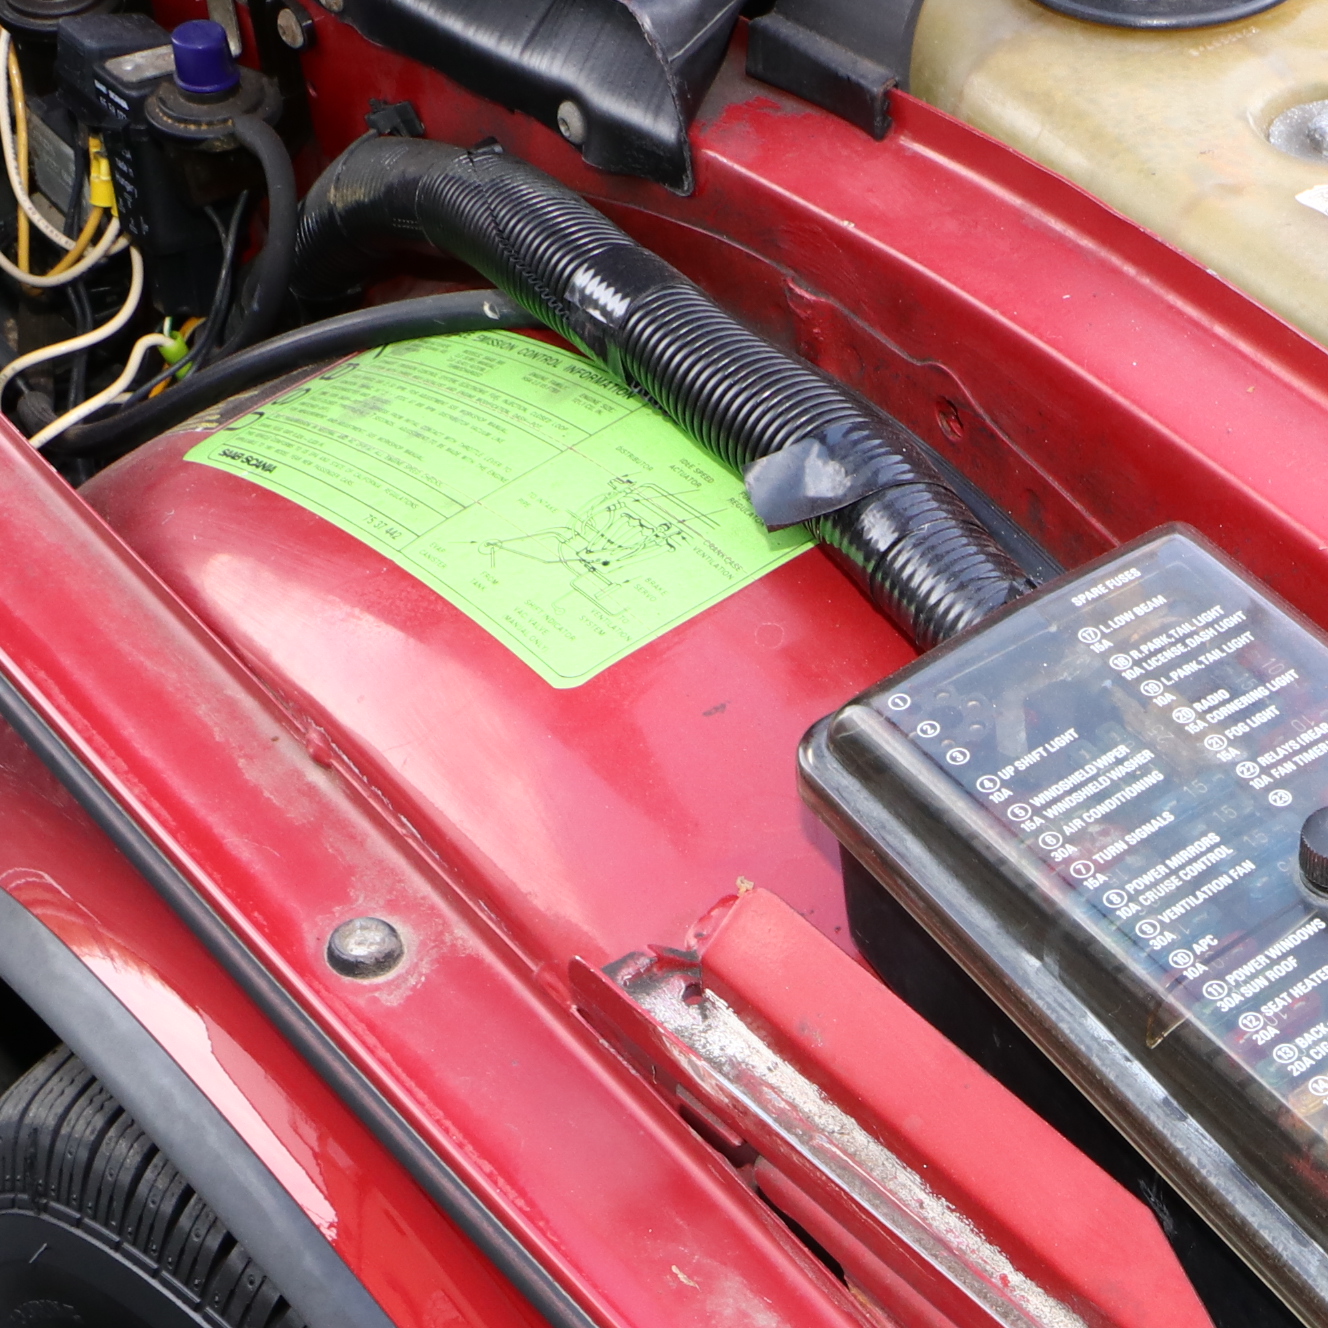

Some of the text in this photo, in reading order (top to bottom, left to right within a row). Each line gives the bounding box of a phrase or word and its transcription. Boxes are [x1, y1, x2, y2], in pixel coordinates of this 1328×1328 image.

[517, 346, 562, 367] CONTROL
[563, 365, 636, 399] INFORMATION
[1070, 567, 1141, 606] SPARE FUSES
[1099, 595, 1167, 633] L.LOW BEAM
[1129, 605, 1225, 660] R.PARK,TAIL LIGHT
[1089, 638, 1113, 653] 15A
[1122, 611, 1248, 680] 10A LICENSE,DASH LIGHT
[1160, 631, 1256, 686] L.PARK,TAIL LIGHT
[1152, 691, 1176, 706] 10A
[1184, 719, 1208, 734] 15A
[1205, 686, 1270, 723] CORNERING
[1265, 669, 1299, 690] LIGHT
[1193, 689, 1231, 711] RADIO
[1224, 706, 1281, 738] FOG LIGHT
[997, 728, 1081, 779] UP SHIFT LIGHT
[1216, 747, 1240, 761] 15A
[1257, 740, 1300, 766] RELAYS
[1020, 749, 1156, 832] 15A WINDSHIELD WASHER
[1029, 745, 1130, 806] WINDSHIELD WIPER
[1249, 774, 1272, 789] 10A
[1271, 761, 1296, 778] FAN
[988, 787, 1013, 804] 10A
[1060, 771, 1166, 835] AIR CONDITIONING
[1050, 843, 1078, 861] 30A
[1092, 811, 1177, 863] TURN SIGNALS
[1083, 872, 1109, 890] 15A
[1115, 844, 1234, 919] 10A CRUISE CONTROL
[1125, 832, 1221, 893] POWER MIRRORS
[1157, 860, 1256, 923] VENTILATION FAN
[1148, 930, 1176, 950] 30A
[1190, 934, 1219, 954] APC
[1224, 918, 1327, 984] POWER WINDOWS
[1182, 962, 1208, 980] 10A
[1215, 956, 1301, 1011] 30A SUN ROOF
[1260, 993, 1293, 1015] SEAT
[1252, 1025, 1279, 1044] 20A
[1286, 1055, 1315, 1076] 20A
